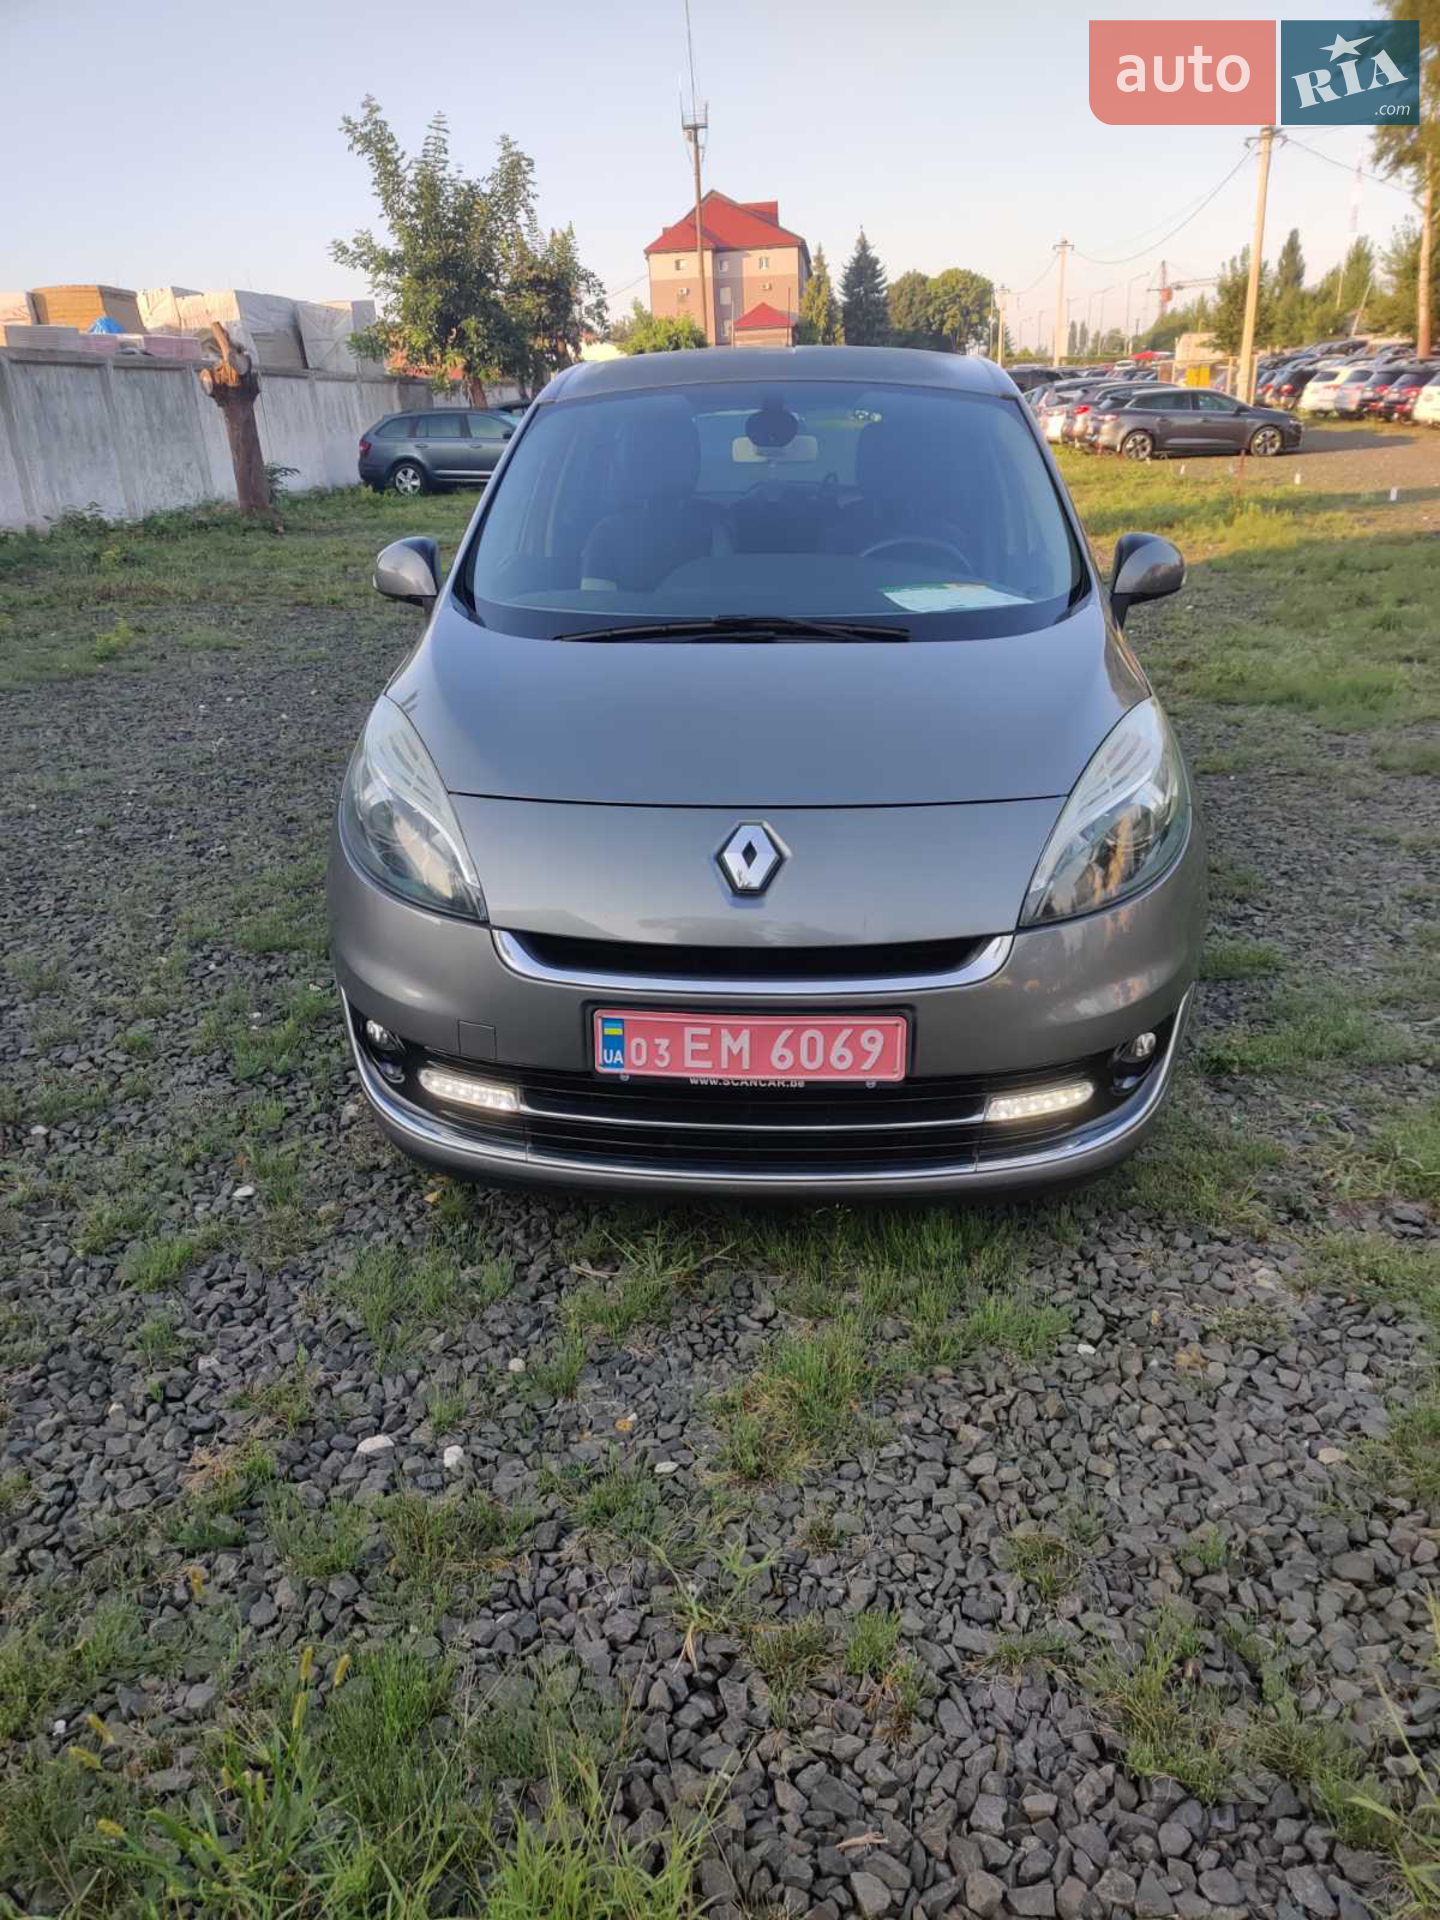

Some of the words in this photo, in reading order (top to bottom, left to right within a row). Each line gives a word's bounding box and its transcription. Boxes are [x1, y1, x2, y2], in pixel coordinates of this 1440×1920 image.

[603, 1049, 624, 1064] UA
[630, 1037, 672, 1067] 03
[684, 1027, 750, 1069] EM
[770, 1028, 885, 1071] 6069
